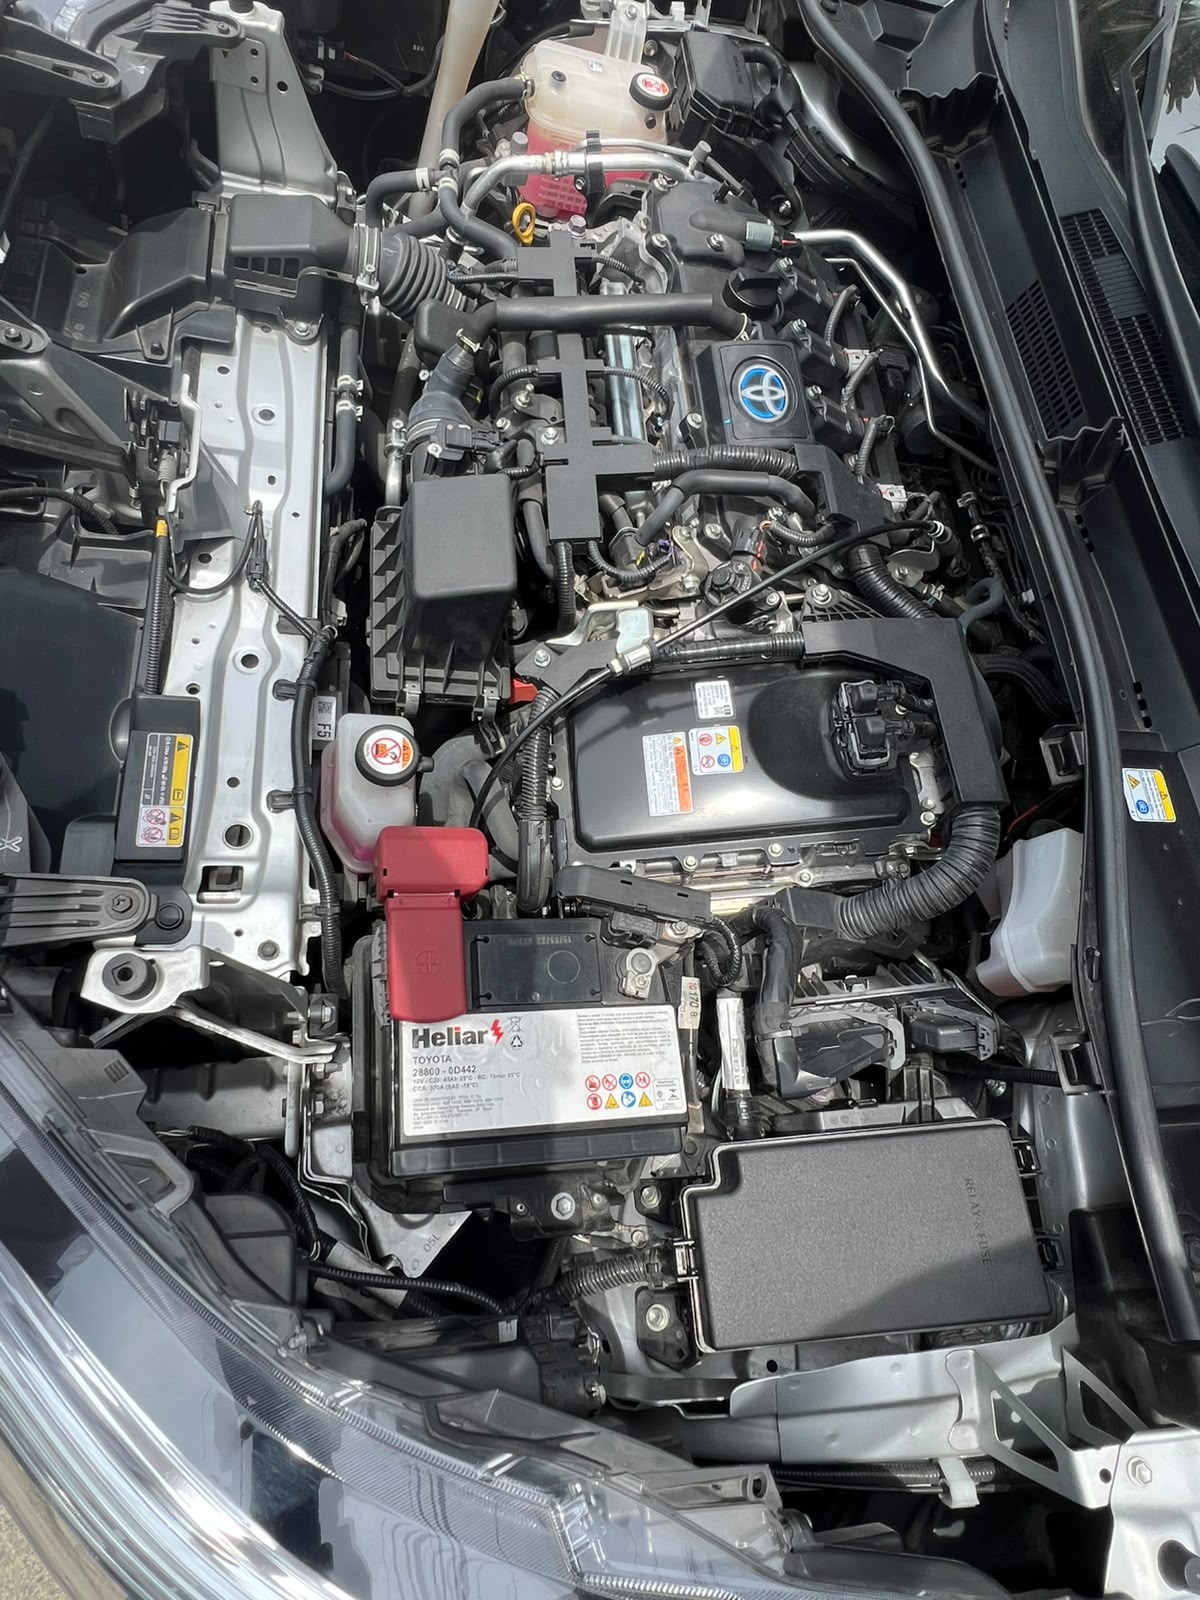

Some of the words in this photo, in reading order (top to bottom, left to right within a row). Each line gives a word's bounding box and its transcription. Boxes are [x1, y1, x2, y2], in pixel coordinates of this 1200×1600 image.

[317, 723, 331, 738] F5
[690, 992, 700, 1008] 170
[412, 1026, 489, 1049] Heliar
[412, 1054, 453, 1065] TOYOTA
[412, 1067, 440, 1078] 28800
[448, 1065, 477, 1075] 0D442
[965, 1178, 981, 1217] RELAY
